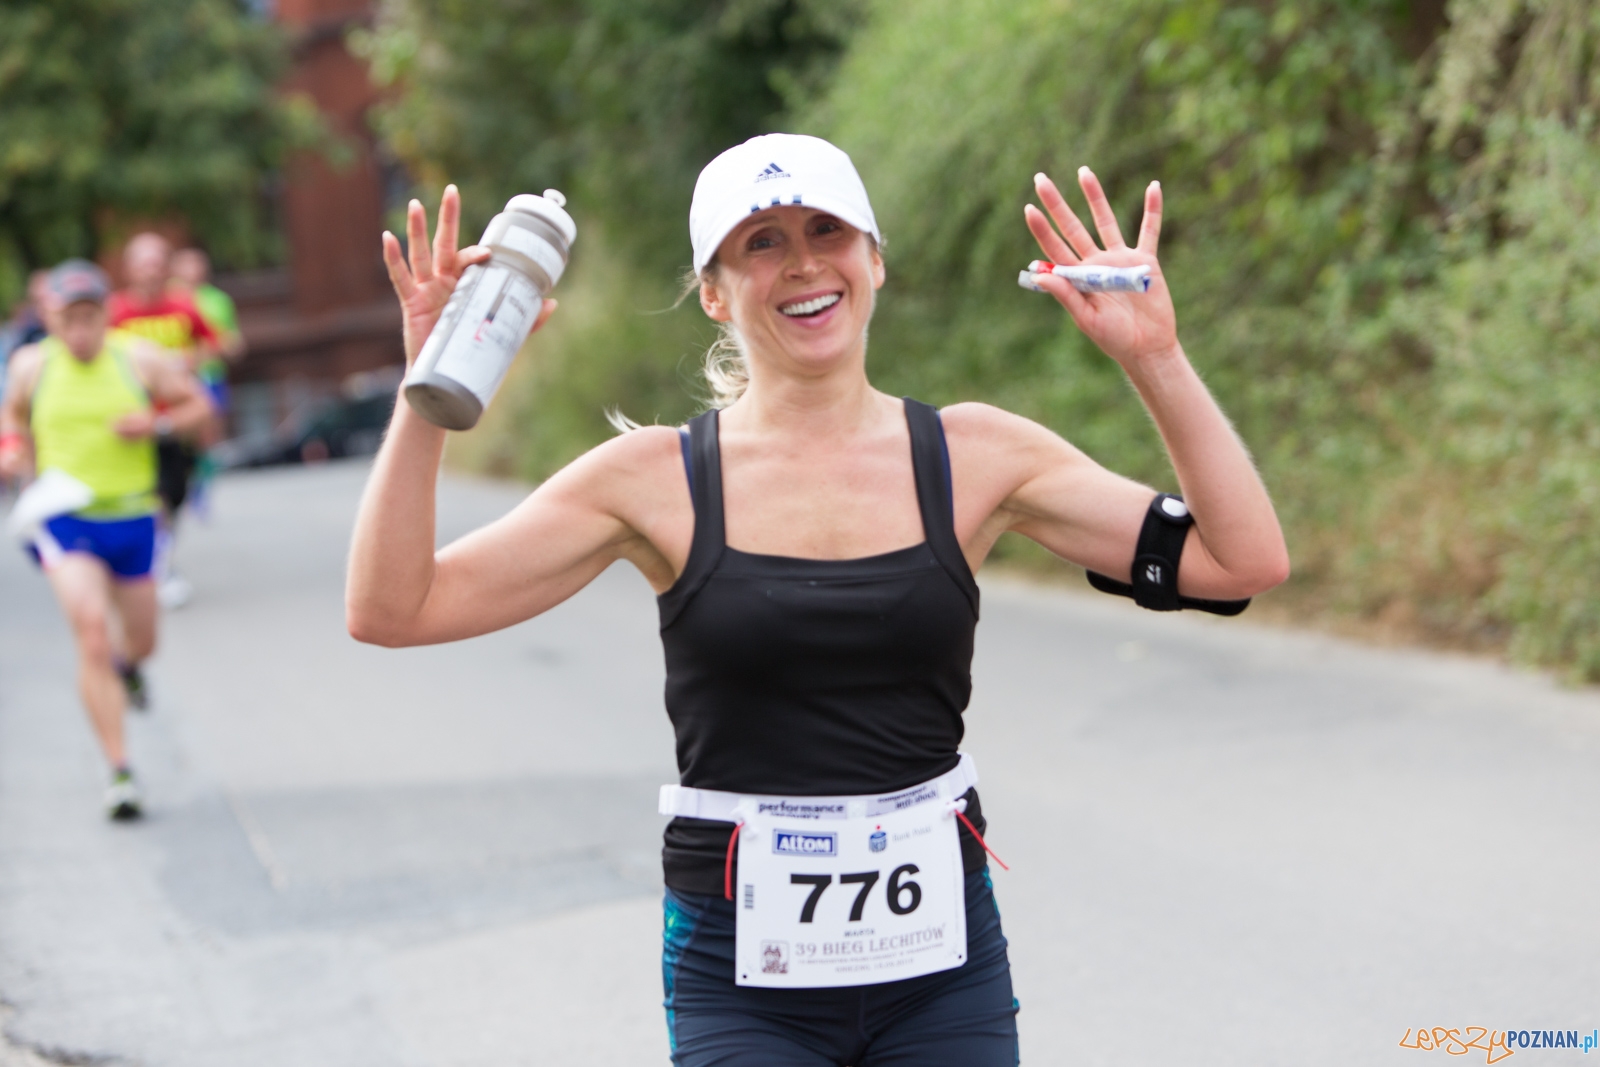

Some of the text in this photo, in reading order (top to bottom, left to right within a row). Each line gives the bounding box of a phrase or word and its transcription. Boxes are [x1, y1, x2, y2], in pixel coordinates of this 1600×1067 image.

[759, 800, 844, 814] performance
[790, 863, 922, 924] 776
[795, 941, 818, 957] 39
[822, 940, 864, 956] BIEG
[869, 925, 943, 953] LECHITÓW
